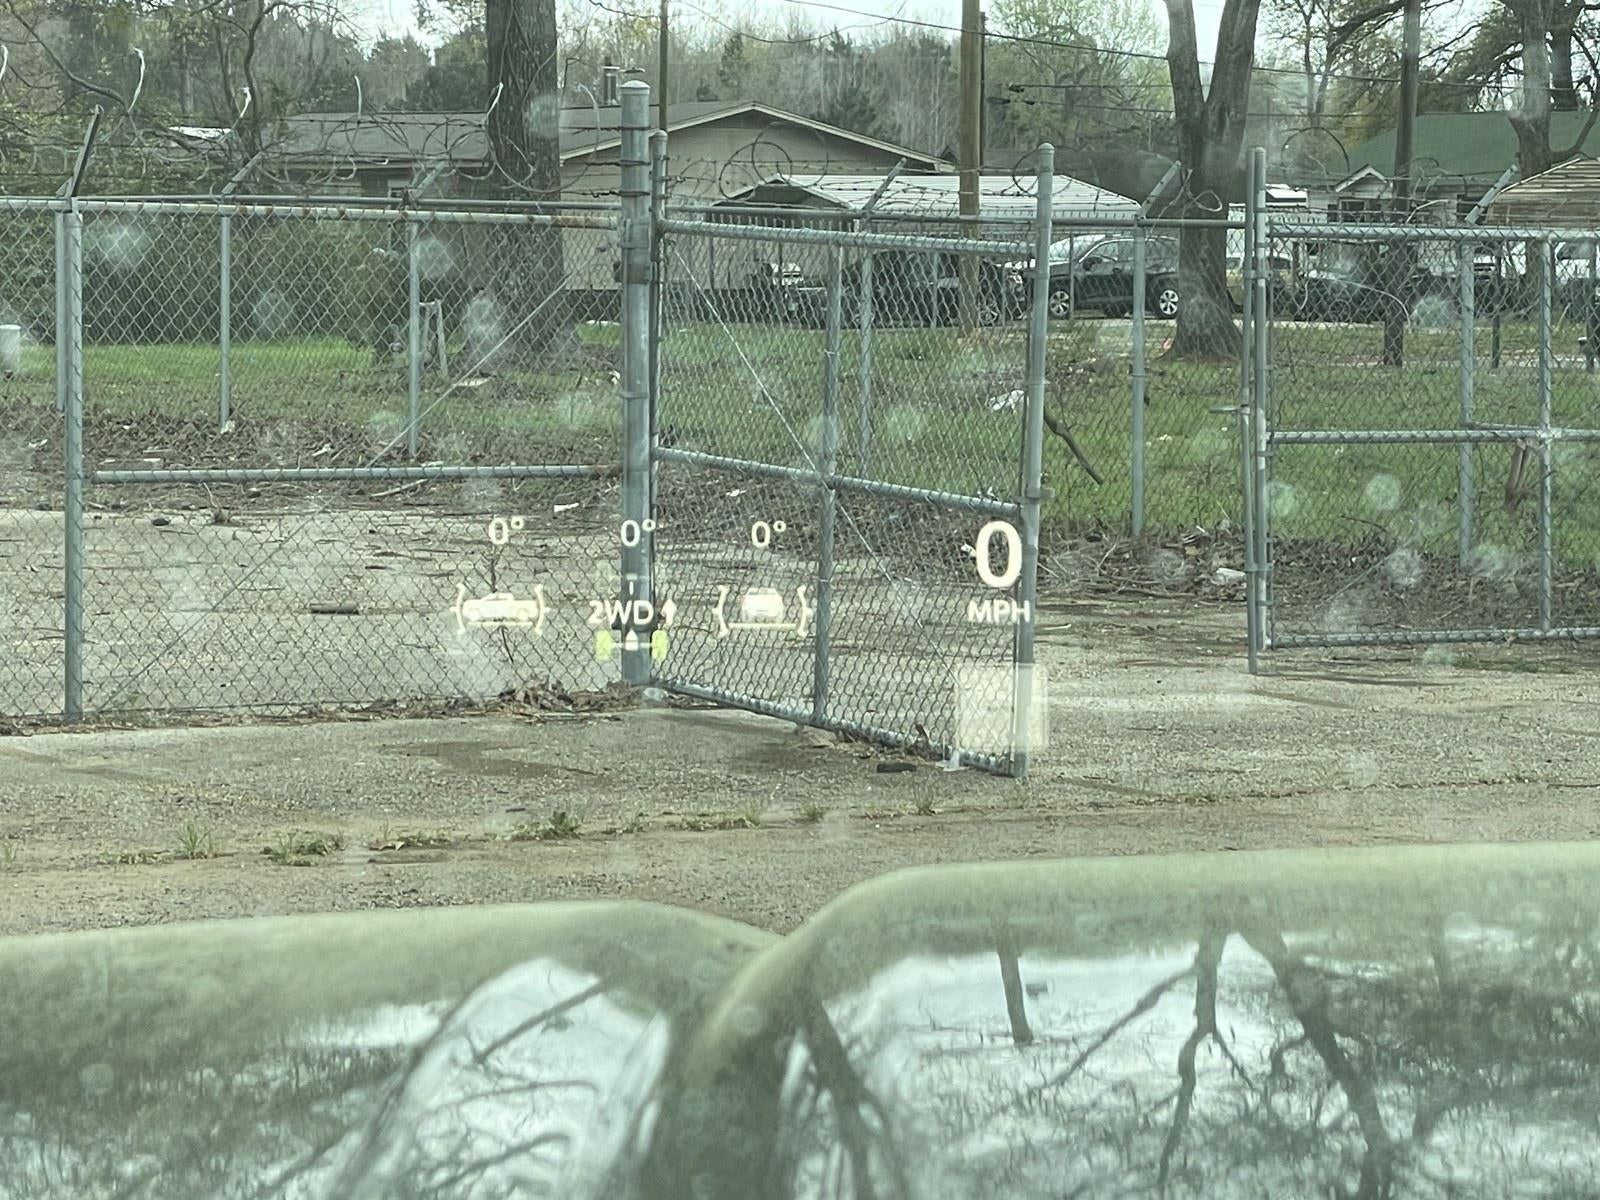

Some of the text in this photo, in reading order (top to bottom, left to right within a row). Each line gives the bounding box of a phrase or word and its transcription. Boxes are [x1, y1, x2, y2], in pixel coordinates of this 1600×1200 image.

[488, 517, 525, 545] 0°
[620, 518, 656, 547] 0°
[751, 520, 786, 548] 0°
[976, 520, 1022, 588] 0
[588, 600, 654, 625] 2WD
[967, 600, 1031, 623] MPH
